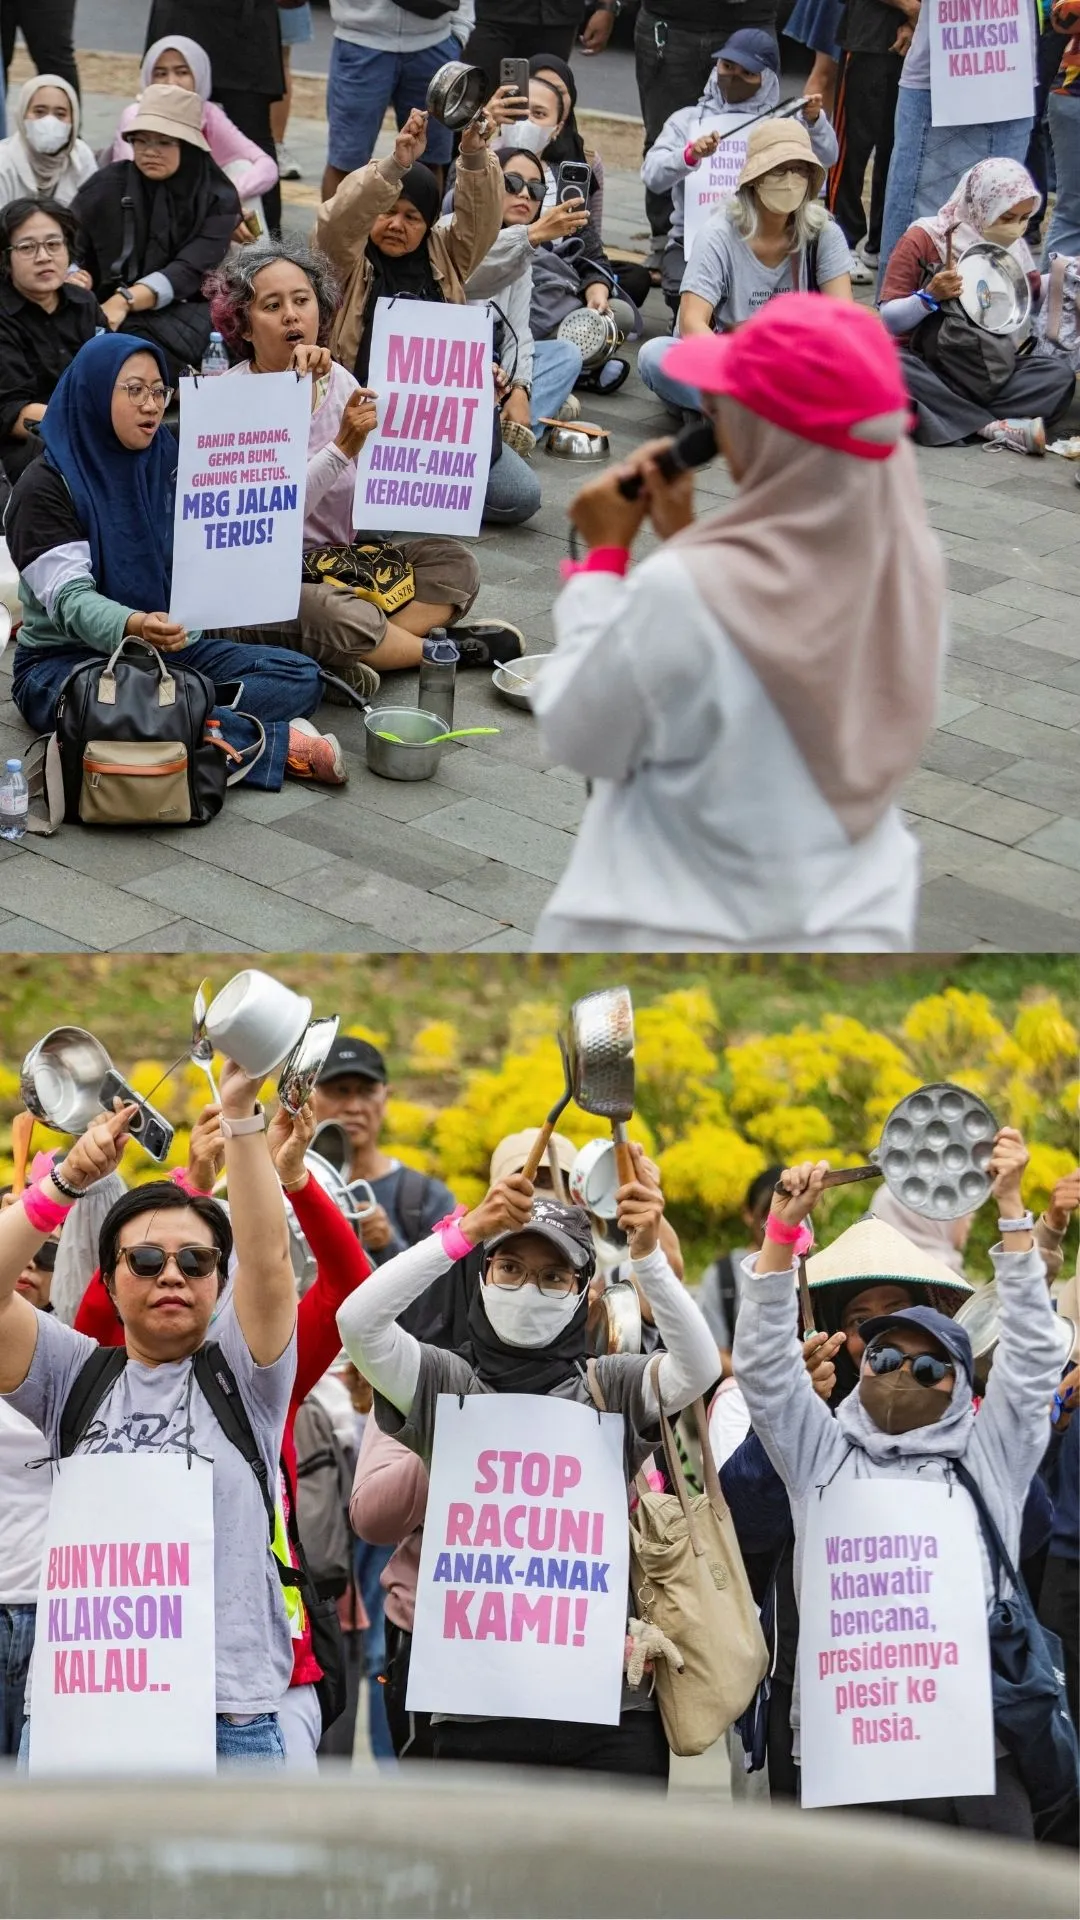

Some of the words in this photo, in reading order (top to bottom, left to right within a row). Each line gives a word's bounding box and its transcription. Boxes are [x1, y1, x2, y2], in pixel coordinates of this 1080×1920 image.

[938, 0, 1018, 23] BUNYIKAN
[942, 21, 1018, 50] KLAKSON
[949, 50, 1016, 77] KALAU..
[710, 156, 744, 169] khaw
[718, 140, 747, 153] arga
[709, 174, 739, 186] benc
[387, 335, 486, 389] MUAK
[381, 392, 479, 444] LIHAT
[197, 433, 235, 449] BANJIR
[238, 429, 291, 445] BANDANG,
[208, 451, 244, 467] GEMPA
[248, 448, 277, 463] BUMI,
[370, 445, 477, 478] ANAK-ANAK
[192, 471, 237, 487] GUNUNG
[240, 466, 290, 483] MELETUS..
[183, 490, 229, 520] MBG
[236, 484, 297, 515] JALAN
[365, 478, 472, 511] KERACUNAN
[204, 518, 274, 550] TERUS!
[474, 1450, 582, 1498] STOP
[445, 1502, 604, 1555] RACUNI
[47, 1542, 189, 1590] BUNYIKAN
[825, 1534, 938, 1565] Warganya
[432, 1552, 610, 1593] ANAK-ANAK
[830, 1566, 933, 1600] khawatir
[48, 1595, 182, 1642] KLAKSON
[443, 1589, 588, 1647] KAMI!
[830, 1606, 937, 1637] bencana,
[54, 1648, 171, 1694] KALAU..
[818, 1641, 959, 1681] presidennya
[835, 1676, 898, 1714] plesir
[907, 1675, 937, 1704] ke
[852, 1712, 921, 1745] Rusia.
